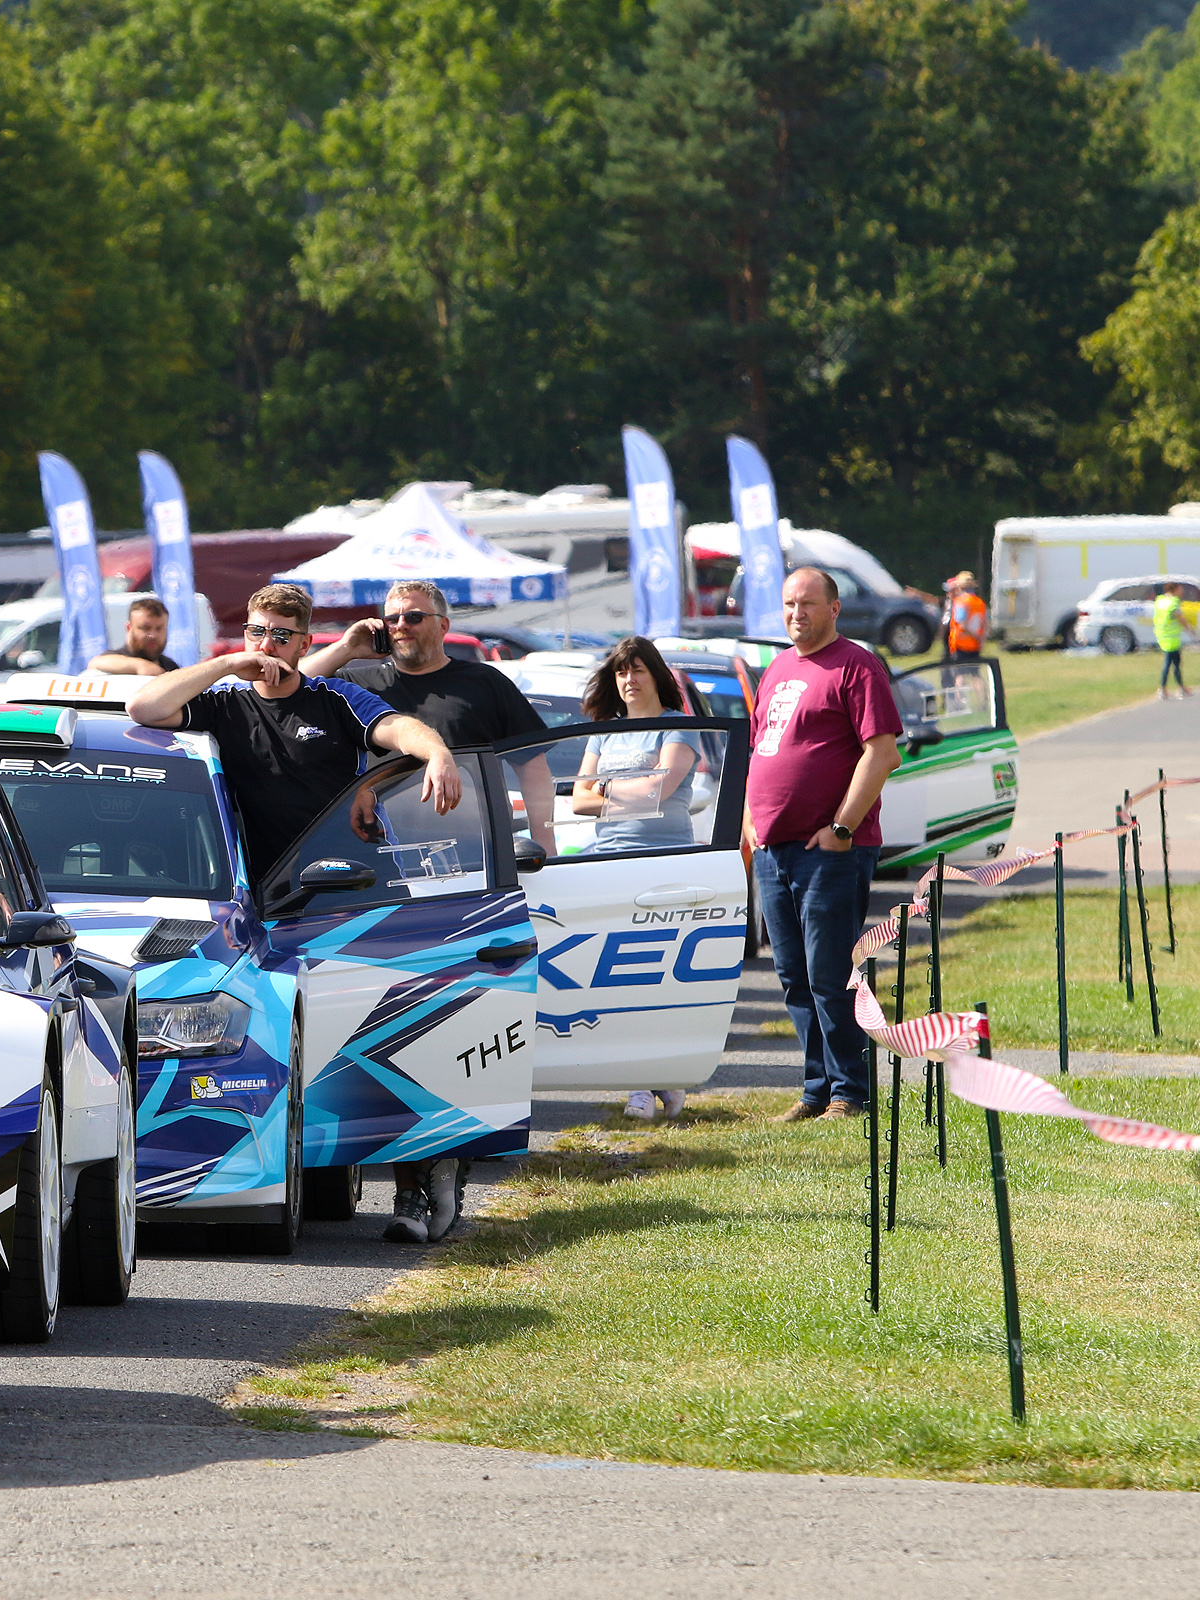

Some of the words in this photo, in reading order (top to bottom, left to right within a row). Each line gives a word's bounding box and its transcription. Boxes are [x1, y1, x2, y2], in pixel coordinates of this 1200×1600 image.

[0, 758, 167, 779] EVANS
[631, 907, 727, 925] UNITED
[456, 1019, 526, 1079] THE
[221, 1078, 267, 1090] MICHELIN
